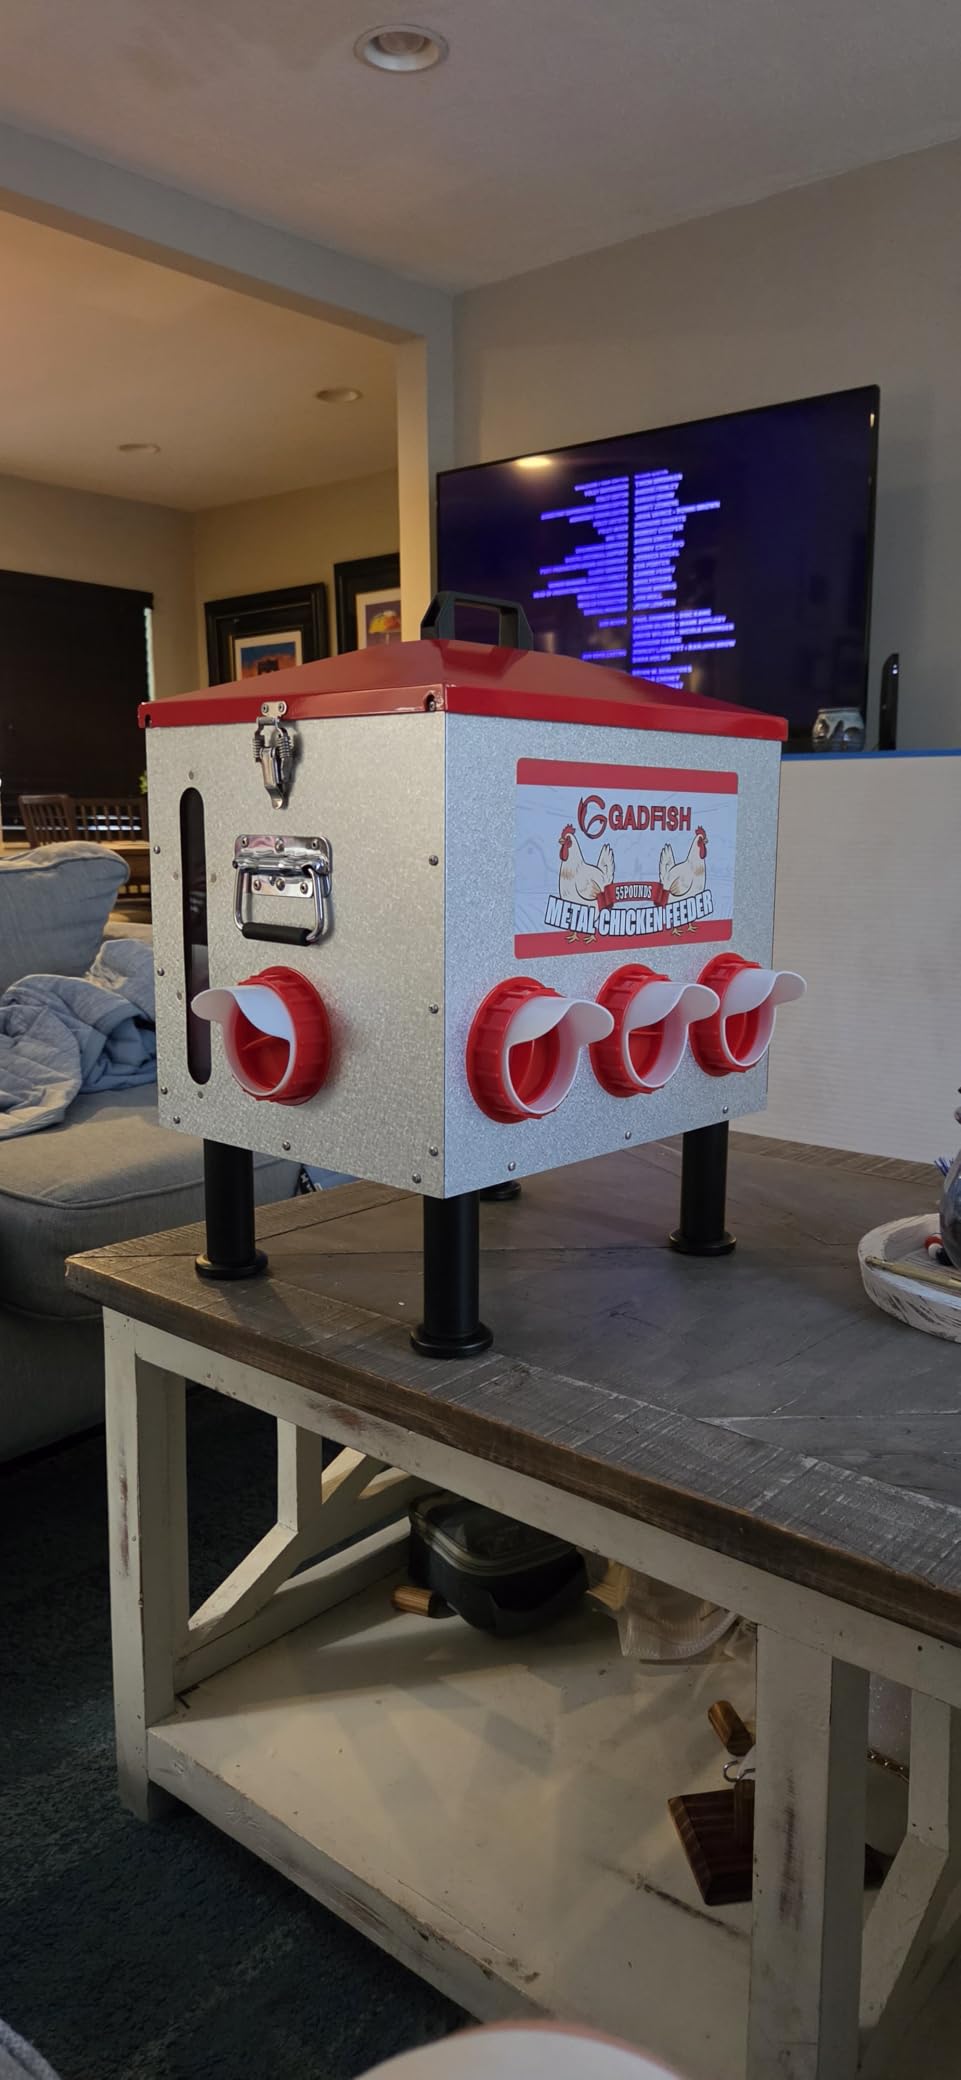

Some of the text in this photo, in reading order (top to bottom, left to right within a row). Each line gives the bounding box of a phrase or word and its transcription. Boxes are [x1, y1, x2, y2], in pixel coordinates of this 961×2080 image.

[608, 804, 692, 831] GADFISH
[615, 886, 652, 900] 55POUNDS
[544, 889, 713, 936] METAL CHICKEN FEEDER
